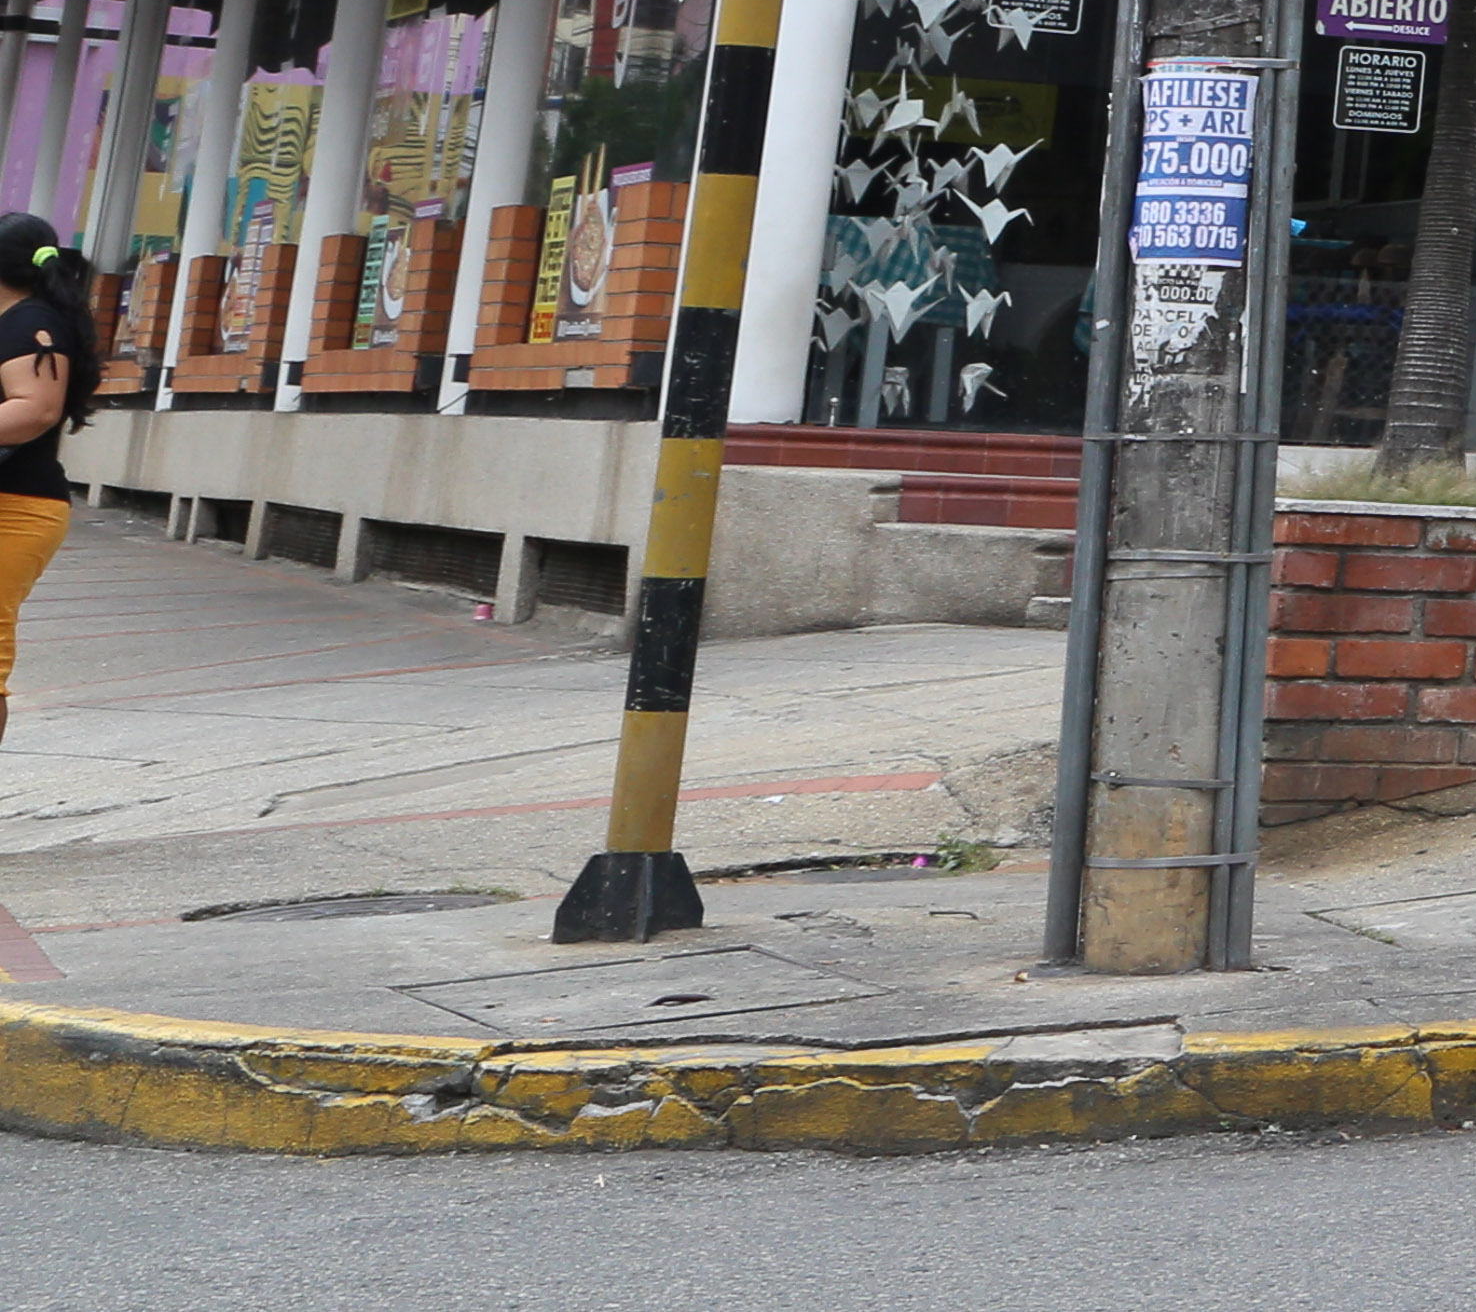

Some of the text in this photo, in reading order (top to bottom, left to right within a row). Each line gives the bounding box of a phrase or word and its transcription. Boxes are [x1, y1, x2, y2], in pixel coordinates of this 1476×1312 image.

[1392, 24, 1431, 36] DESLICE
[1349, 52, 1417, 68] HORARIO
[1150, 80, 1241, 108] AFILIESE
[1146, 109, 1170, 133] PS
[1201, 110, 1247, 135] ARL
[1141, 201, 1226, 226] 680 3336
[1154, 225, 1191, 248] 563
[1195, 226, 1238, 249] 0715
